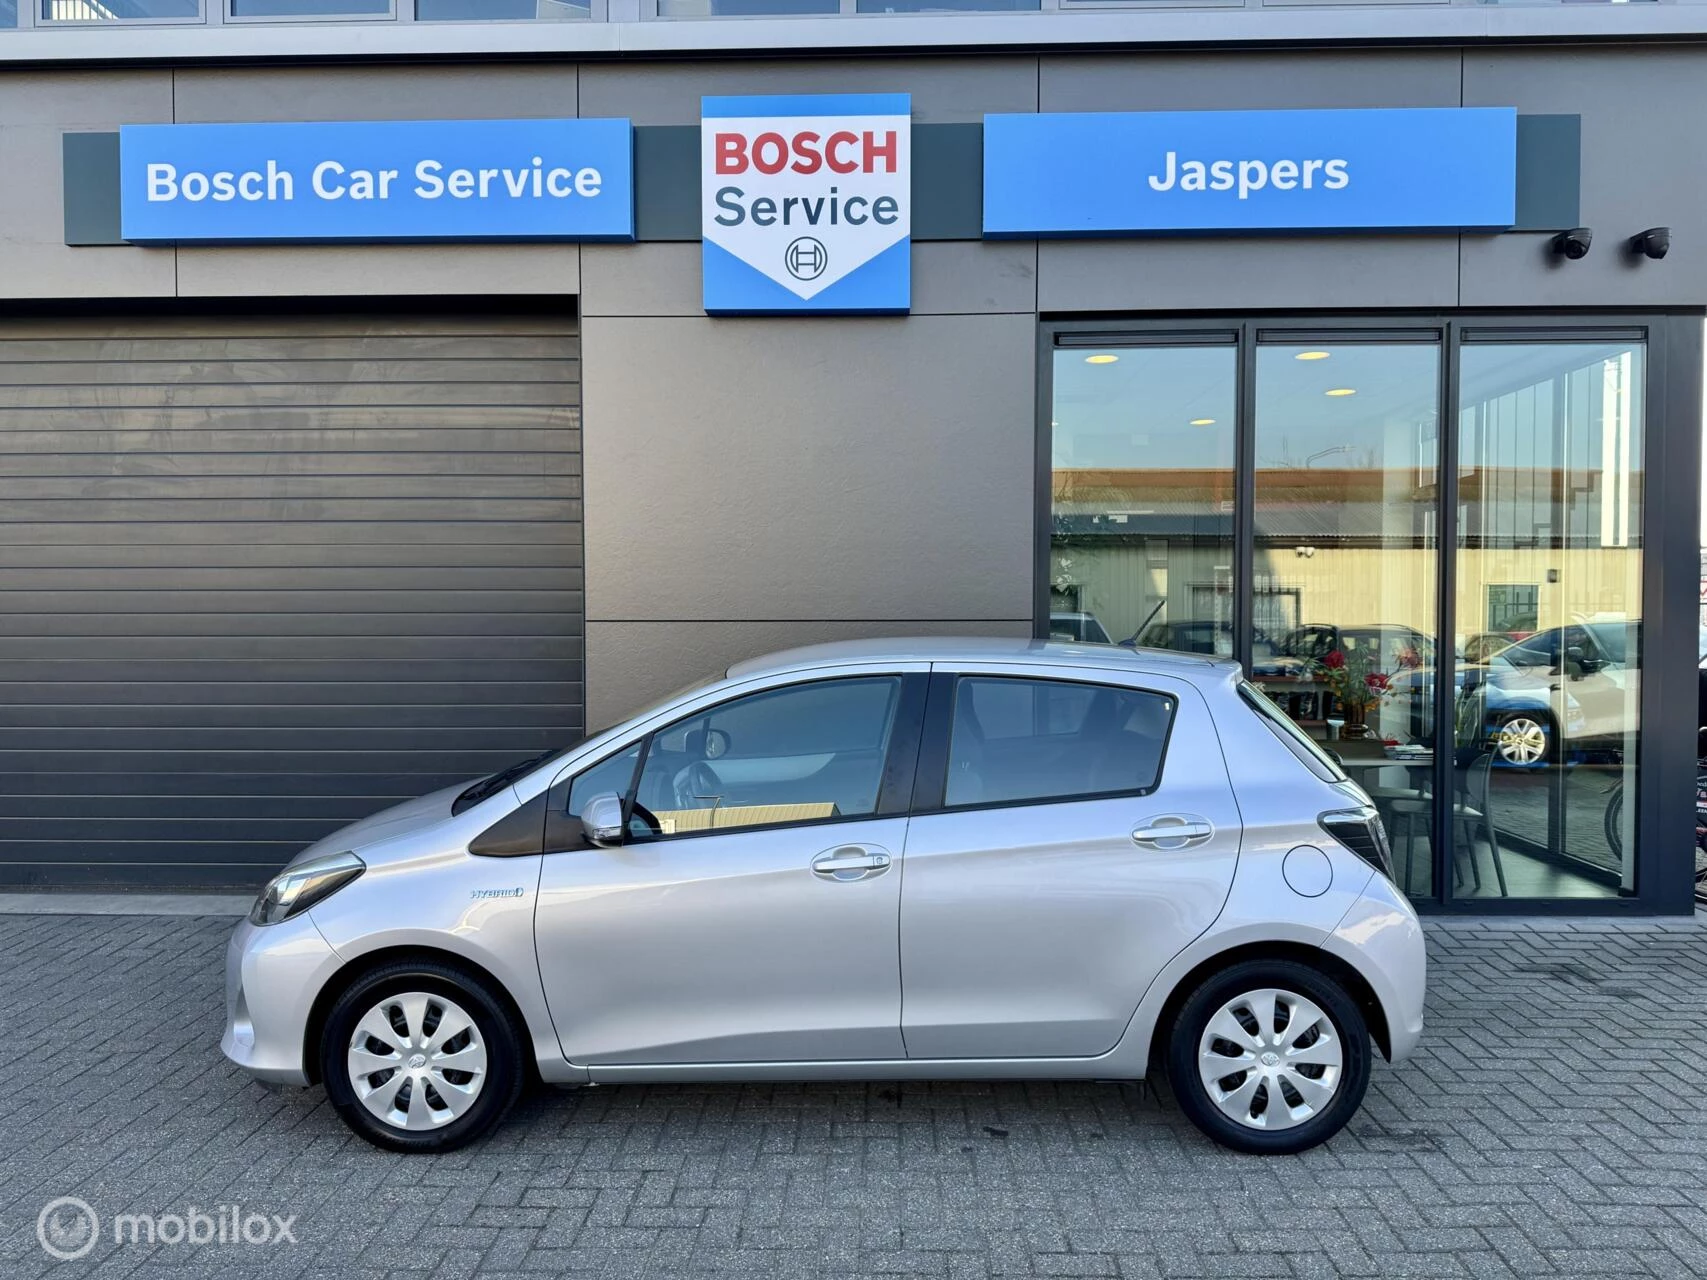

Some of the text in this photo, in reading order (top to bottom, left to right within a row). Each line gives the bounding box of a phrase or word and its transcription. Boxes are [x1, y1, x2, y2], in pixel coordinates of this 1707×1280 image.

[715, 130, 897, 175] BOSCH
[147, 156, 602, 201] Bosch Car Service
[1148, 151, 1350, 200] Jaspers
[714, 186, 899, 226] Service
